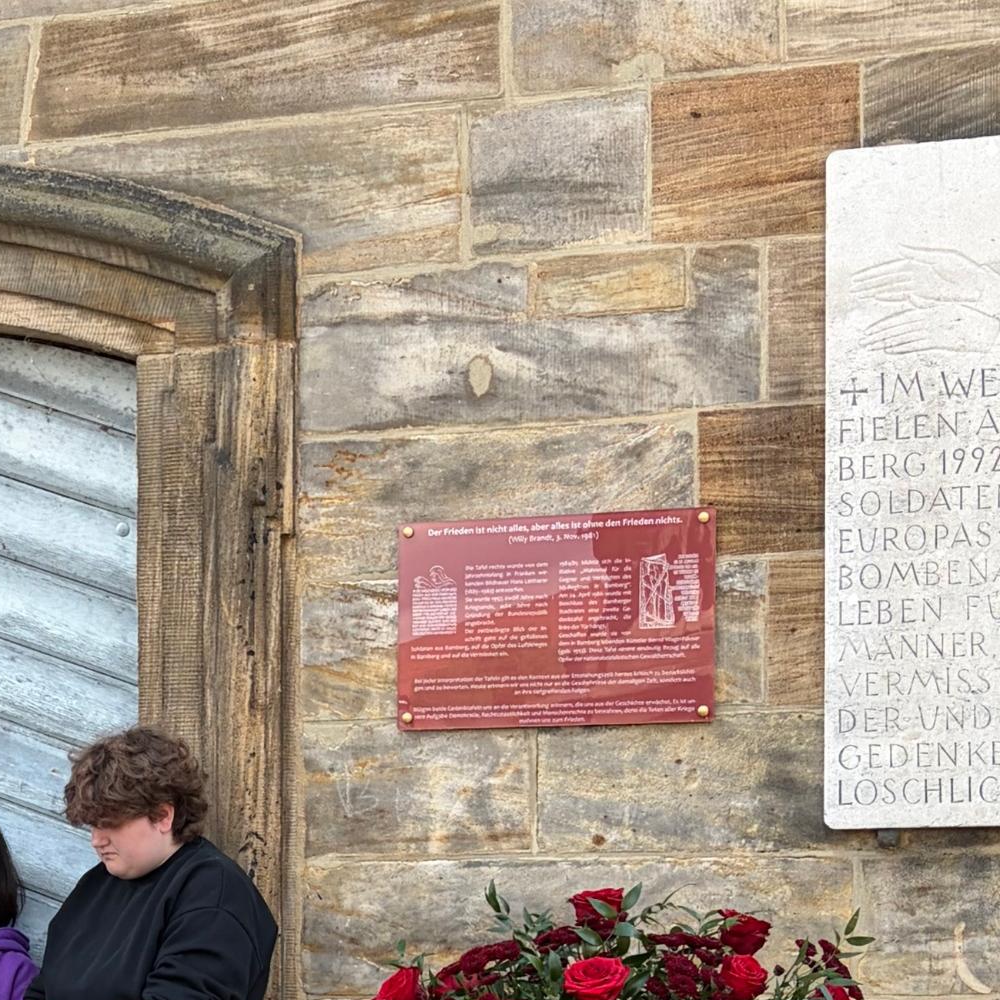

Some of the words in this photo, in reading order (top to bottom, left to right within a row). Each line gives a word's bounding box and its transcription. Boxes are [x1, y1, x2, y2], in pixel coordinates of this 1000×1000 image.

[880, 371, 925, 404] IM
[840, 411, 967, 443] FIELEN
[839, 451, 926, 481] BERG
[838, 484, 1000, 517] SOLDATE
[428, 528, 441, 536] Der
[443, 526, 473, 535] Frieden
[475, 525, 484, 534] ist
[486, 524, 506, 533] nicht
[509, 523, 528, 532] alles,
[530, 522, 549, 531] aber
[551, 521, 569, 530] alles
[571, 520, 579, 529] ist
[582, 519, 603, 528] ohne
[605, 518, 620, 527] den
[622, 516, 653, 526] Frieden
[654, 515, 682, 524] nichts.
[529, 533, 554, 543] Brandt,
[563, 532, 579, 540] Nov.
[839, 521, 992, 553] EUROPAS
[839, 597, 942, 626] LEBEN
[840, 668, 1000, 696] VERMISS
[839, 706, 905, 734] DER
[918, 704, 992, 731] UND
